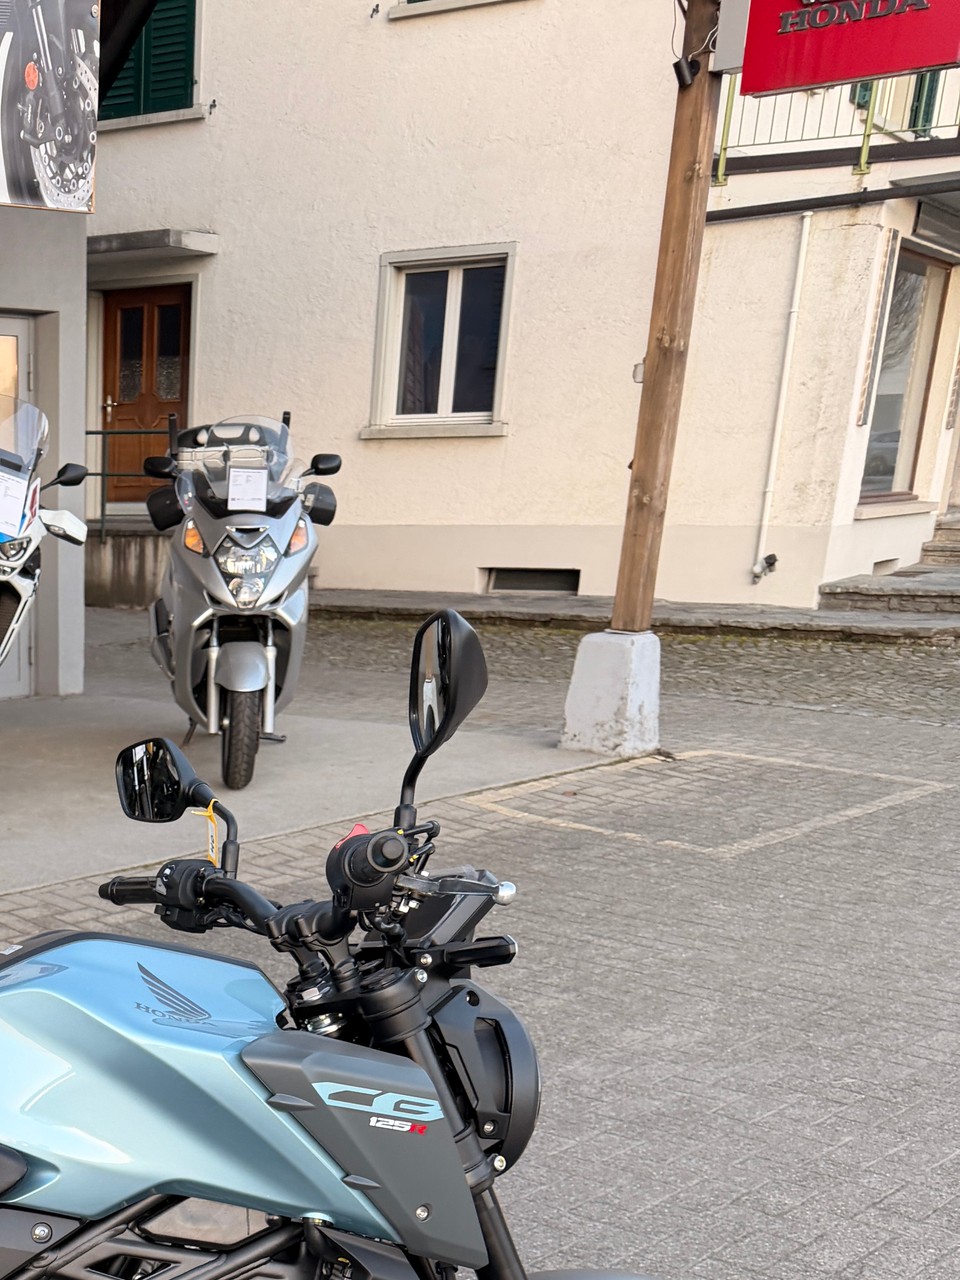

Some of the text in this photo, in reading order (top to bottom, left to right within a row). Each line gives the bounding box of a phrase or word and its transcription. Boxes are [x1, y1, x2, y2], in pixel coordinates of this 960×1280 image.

[134, 1002, 218, 1027] HONDA
[311, 1081, 445, 1122] CB
[369, 1116, 428, 1136] 125R
